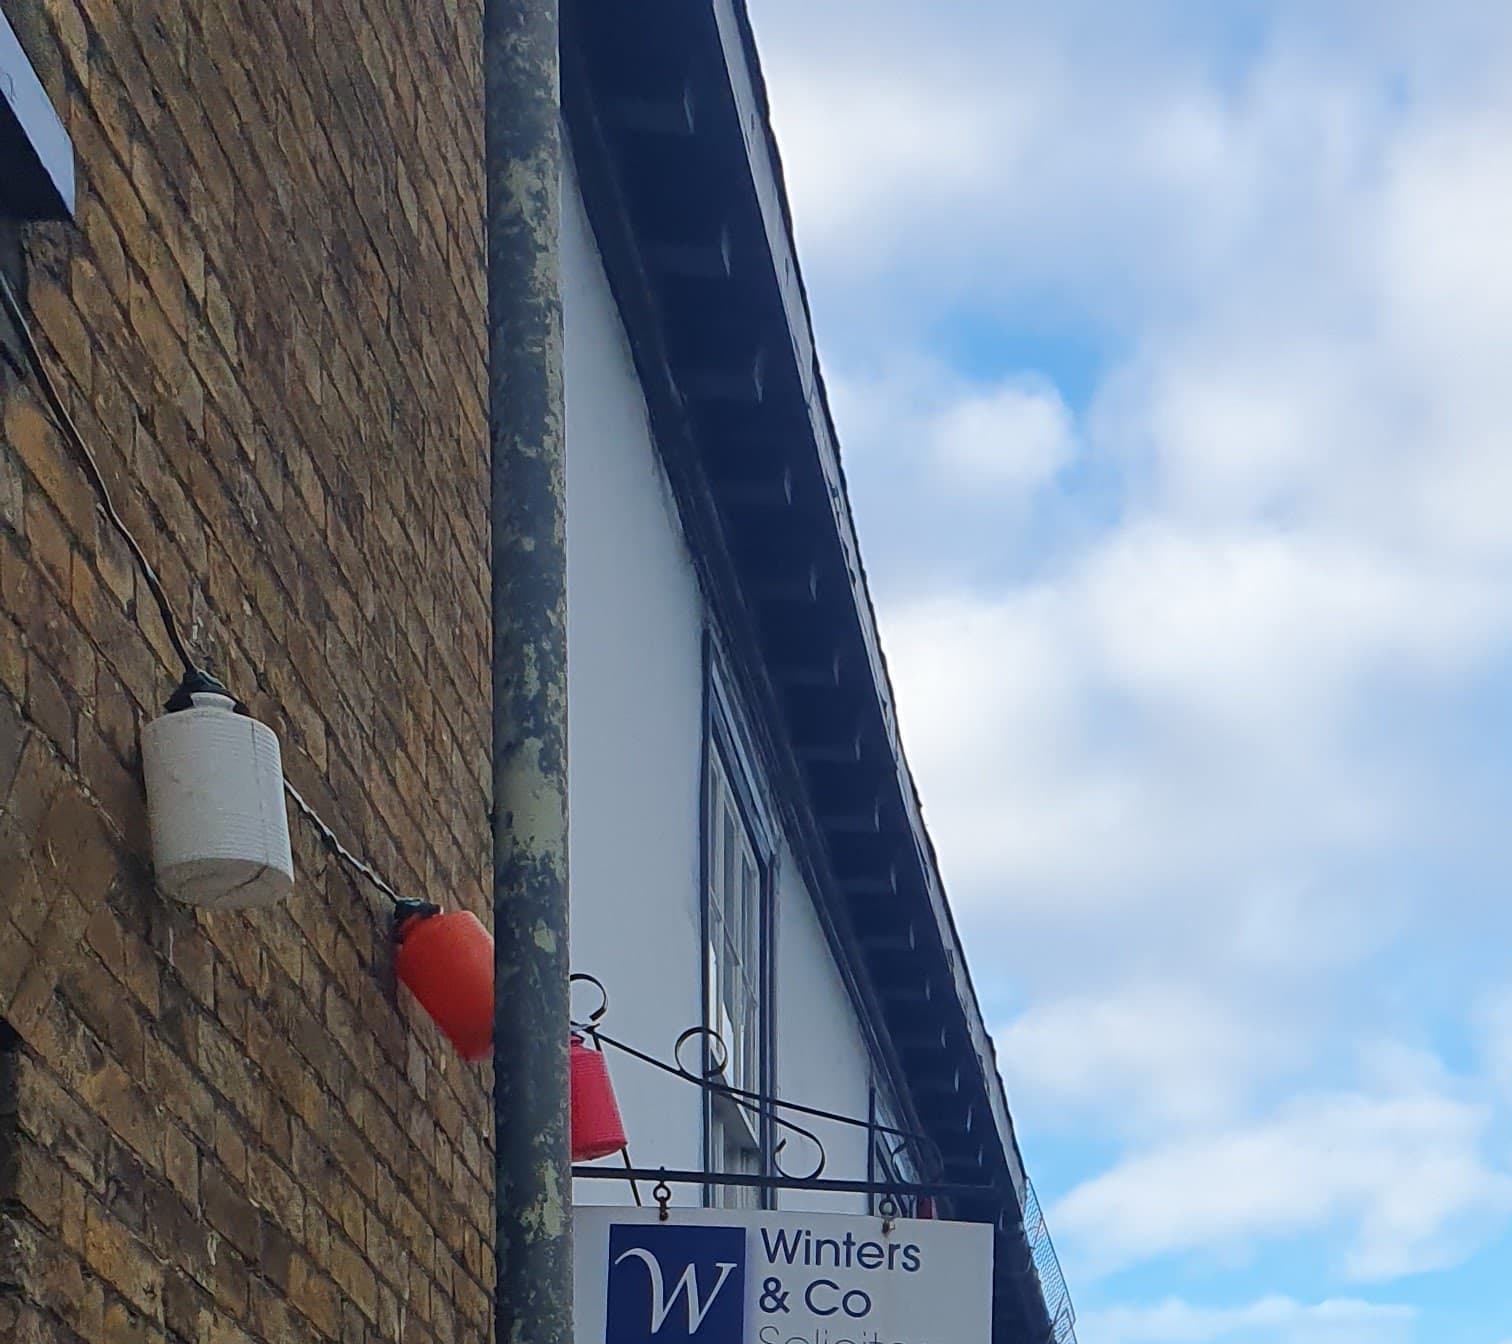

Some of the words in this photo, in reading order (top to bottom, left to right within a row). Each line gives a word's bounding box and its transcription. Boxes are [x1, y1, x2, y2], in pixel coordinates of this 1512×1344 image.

[760, 1227, 921, 1273] Winters
[614, 1247, 737, 1336] W
[759, 1277, 789, 1314] &
[804, 1280, 872, 1318] Co
